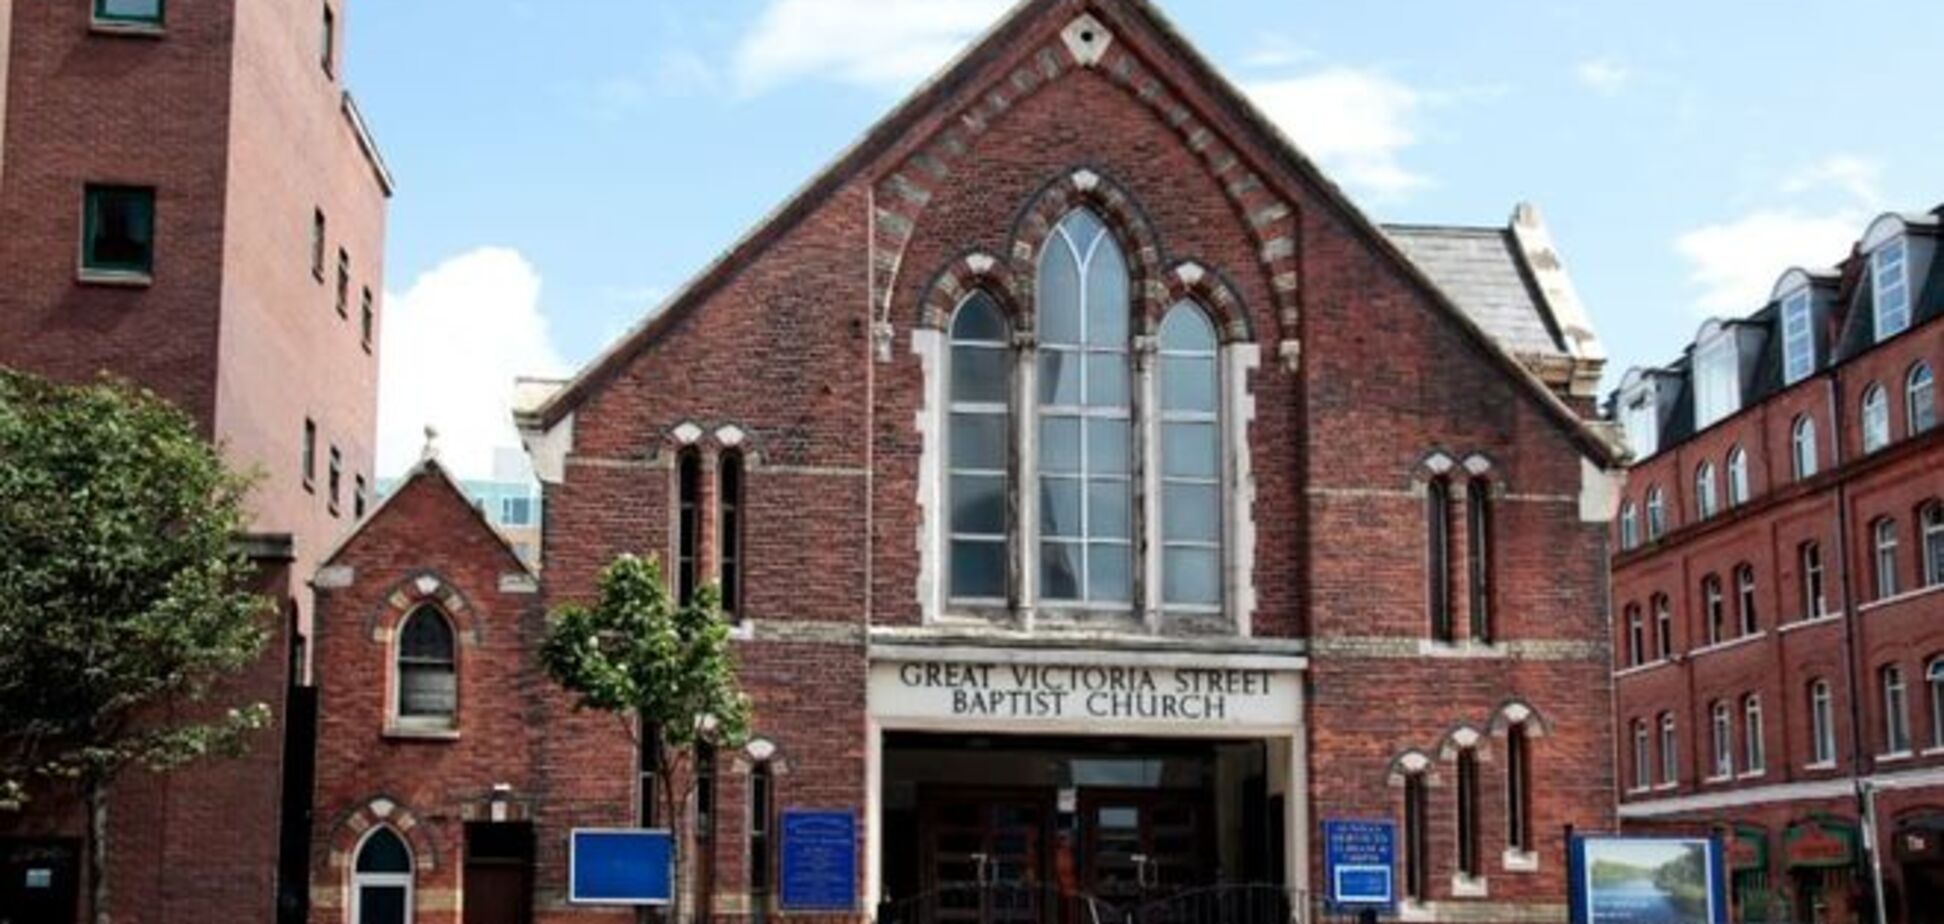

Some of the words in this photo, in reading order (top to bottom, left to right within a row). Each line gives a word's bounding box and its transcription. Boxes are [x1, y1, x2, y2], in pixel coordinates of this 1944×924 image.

[899, 664, 990, 688] GREAT
[1013, 667, 1156, 691] VICTORIA
[1175, 670, 1272, 695] STREET
[952, 691, 1064, 716] BAPTIST
[1086, 694, 1226, 720] CHURCH
